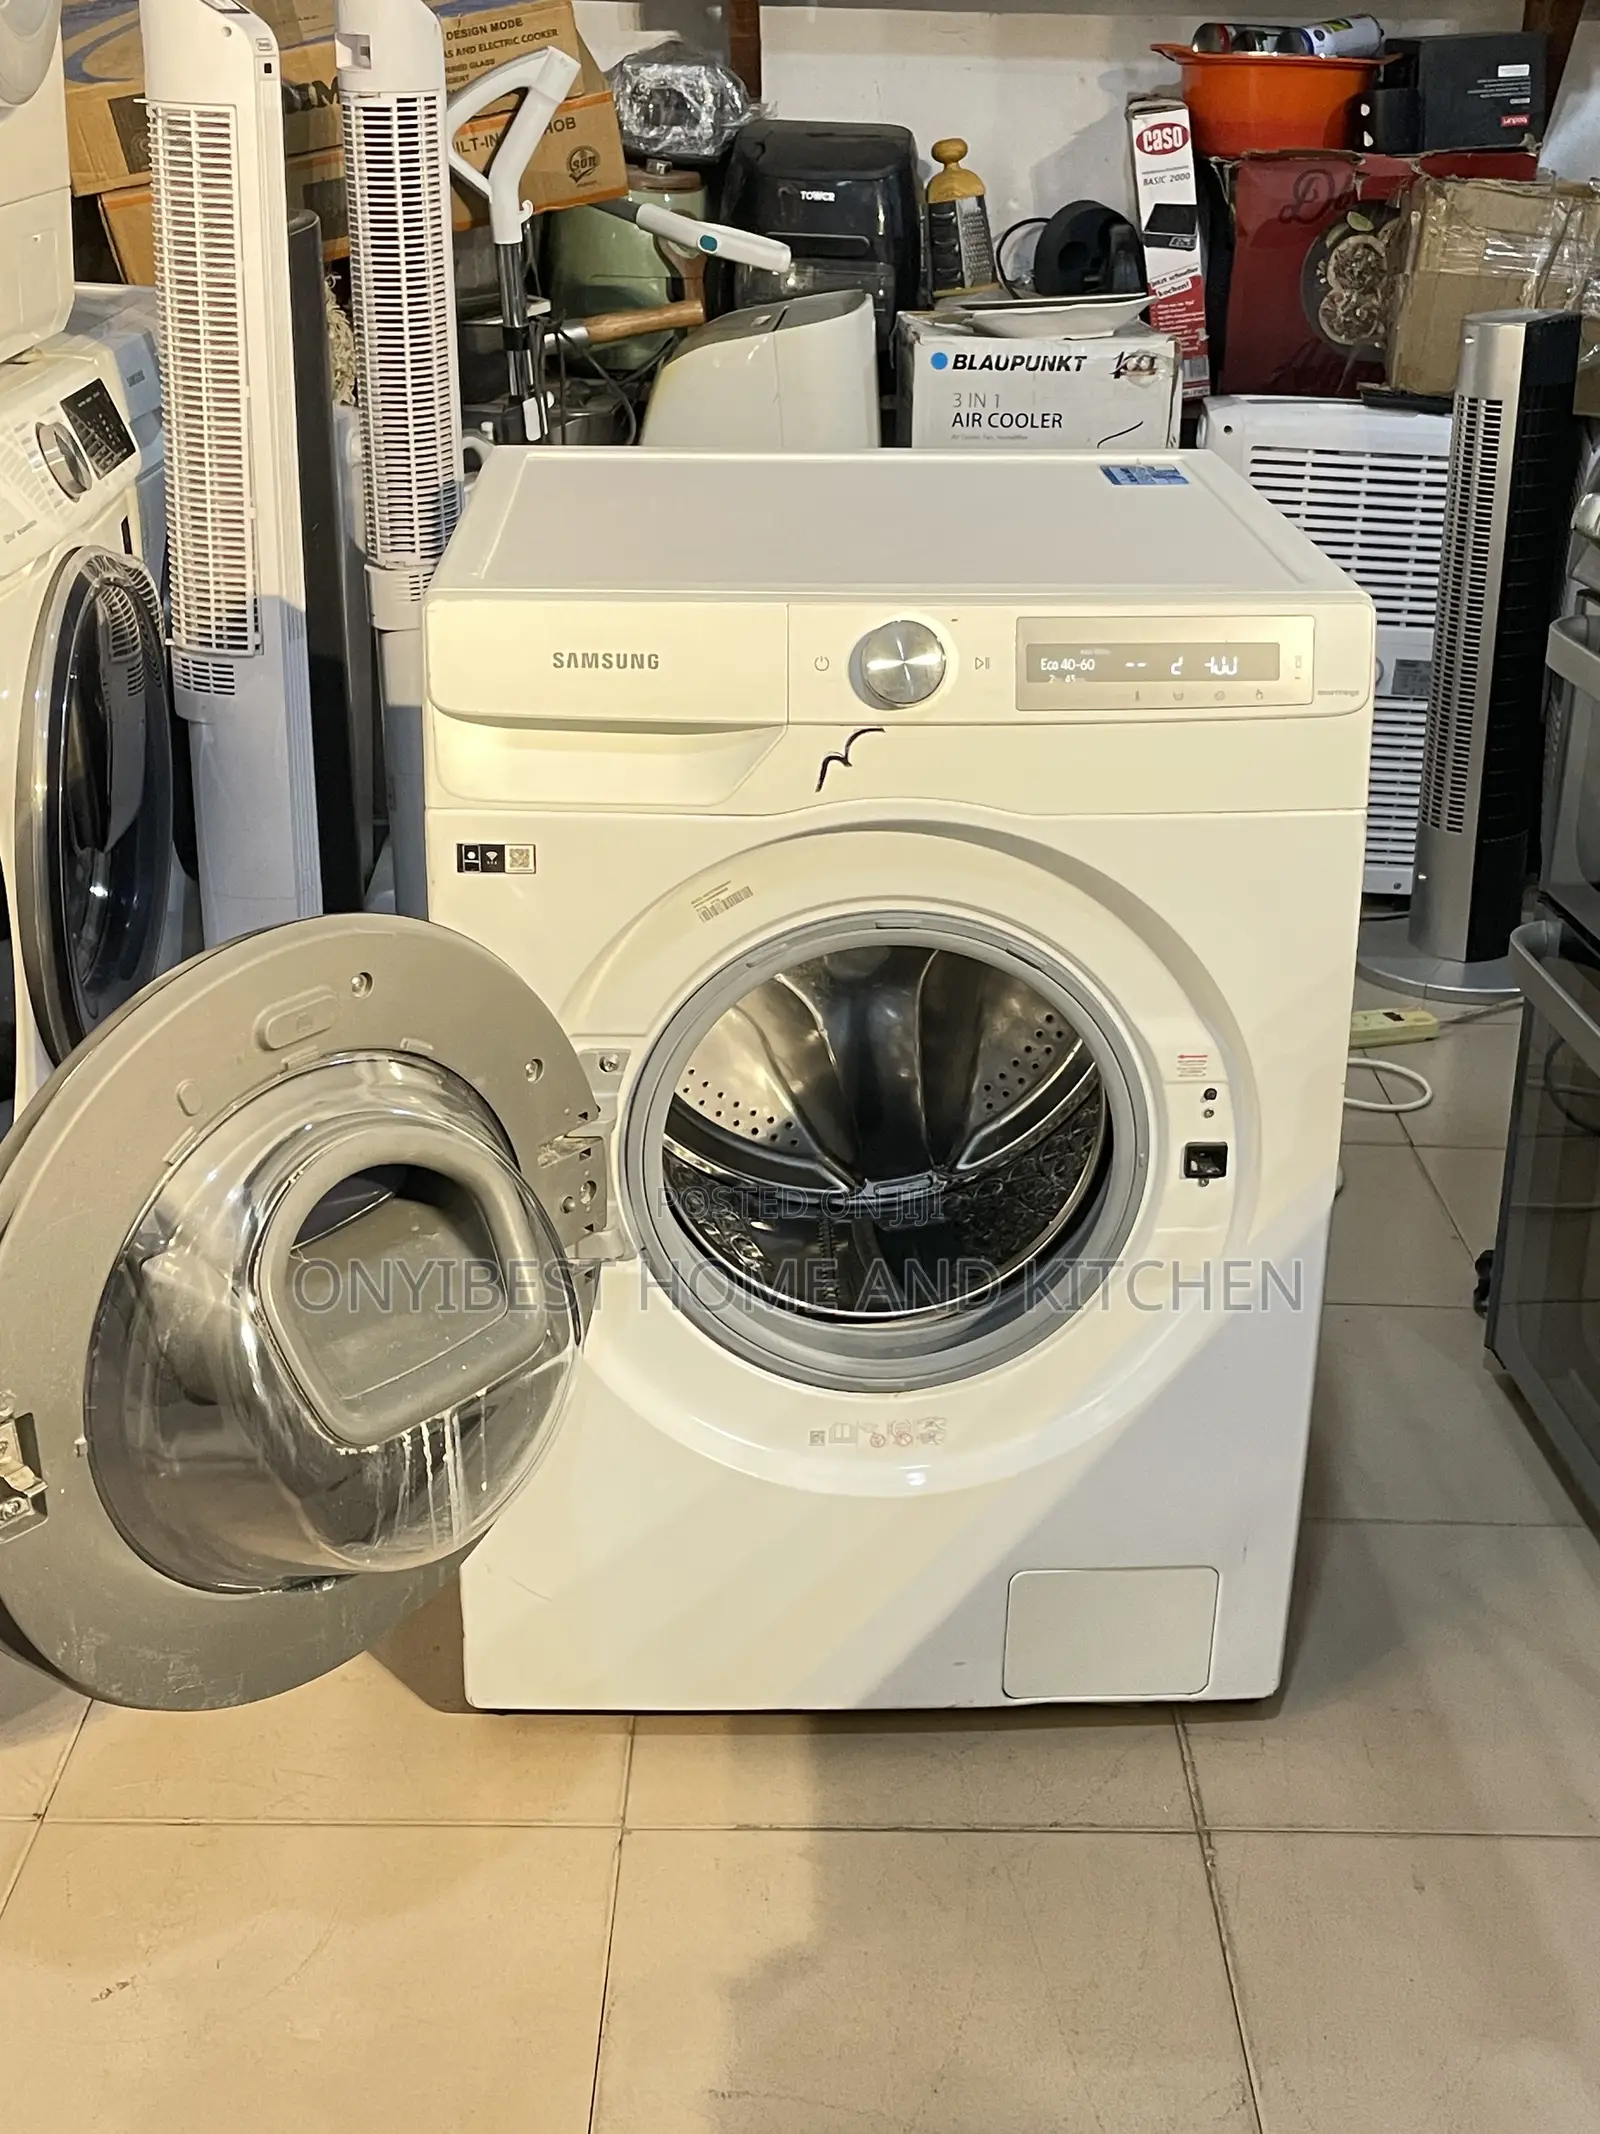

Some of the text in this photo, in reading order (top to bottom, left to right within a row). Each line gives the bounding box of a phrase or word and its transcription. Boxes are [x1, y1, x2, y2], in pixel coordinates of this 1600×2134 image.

[446, 17, 524, 41] DESIGN MODE
[455, 46, 477, 57] AND
[478, 37, 520, 52] ELECTRIC
[521, 28, 559, 44] COOKER
[1143, 172, 1191, 186] BASIC 2000
[952, 354, 1087, 371] BLAUPUNKT
[952, 392, 1000, 409] 3 IN 1
[952, 412, 1063, 429] AIR COOLER
[552, 652, 660, 669] SAMSUNG
[1040, 657, 1059, 671] Eco
[1060, 657, 1096, 671] 40-60
